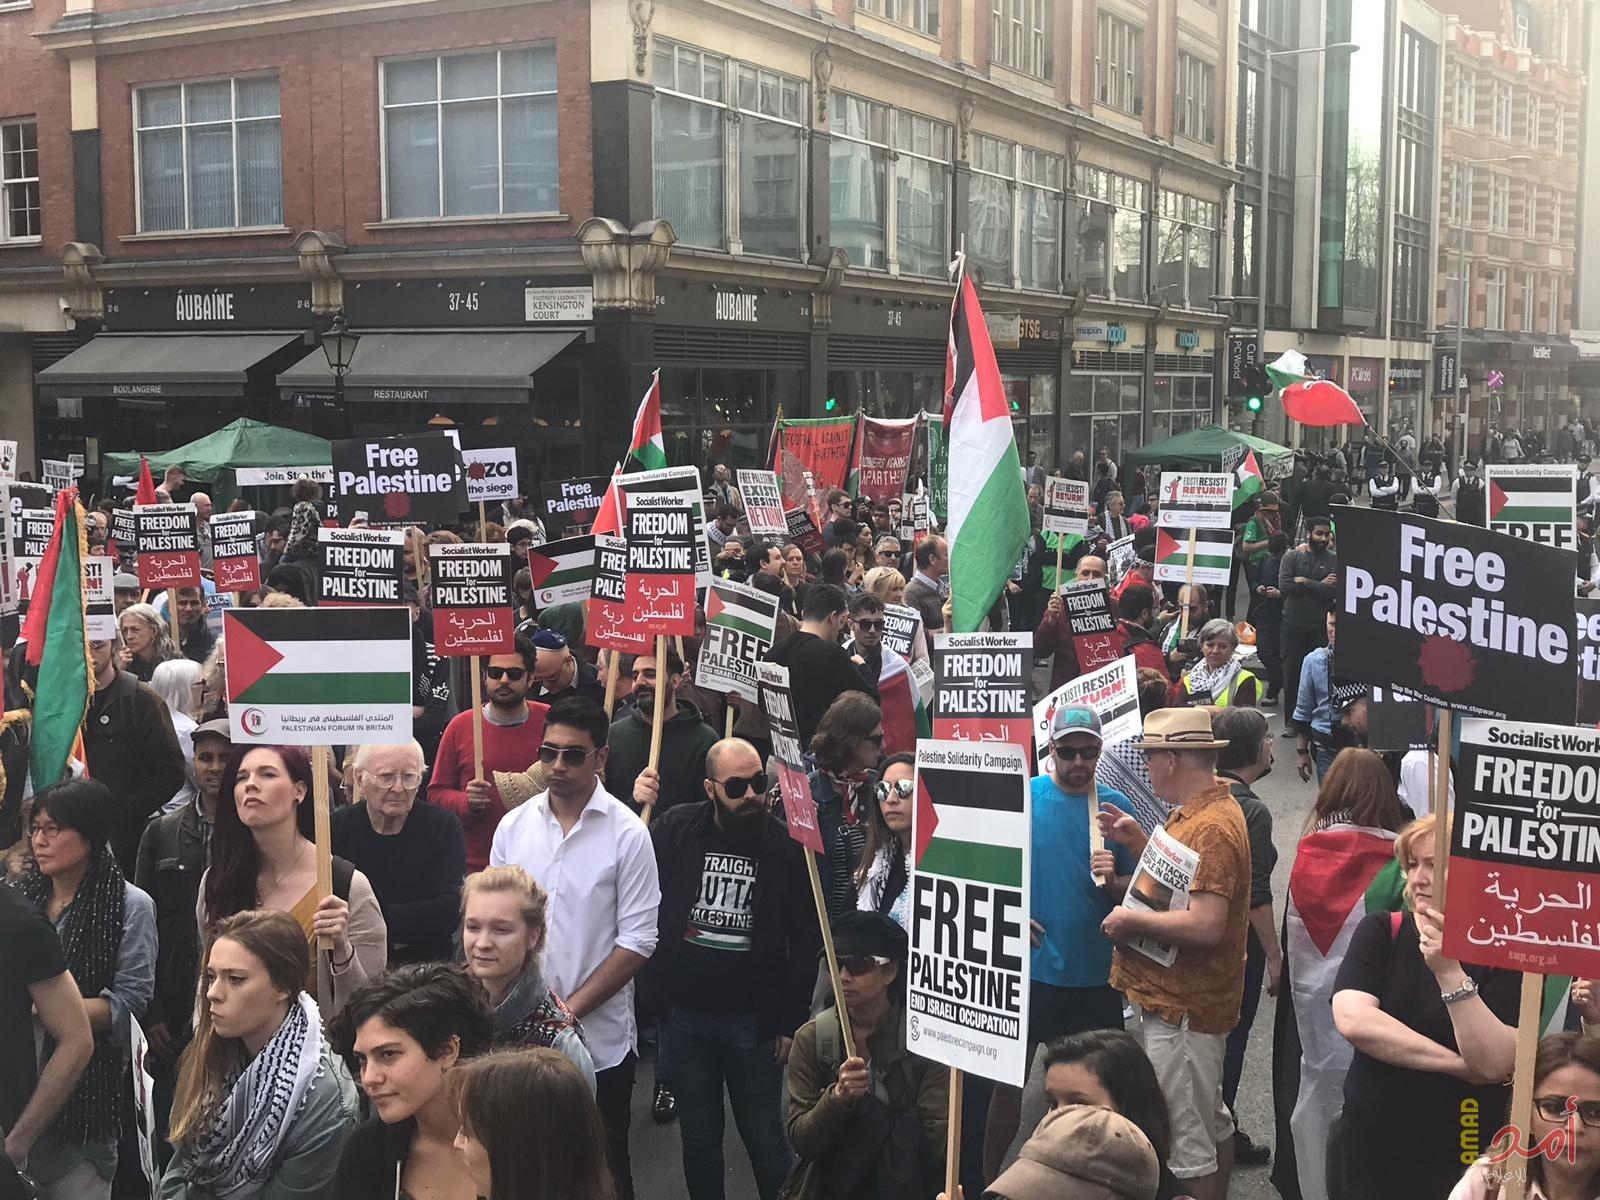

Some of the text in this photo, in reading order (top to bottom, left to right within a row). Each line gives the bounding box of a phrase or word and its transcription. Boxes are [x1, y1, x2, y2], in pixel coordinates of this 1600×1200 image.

[449, 292, 479, 312] 37-45
[533, 301, 584, 310] KENSINGTON
[716, 292, 758, 322] AUBAINE
[532, 310, 560, 320] COURT
[1076, 326, 1102, 335] maplin
[113, 386, 162, 394] BOULANGERIE
[374, 390, 428, 400] RESTAURANT
[786, 430, 848, 446] FOOTBALL AGAINST
[366, 444, 418, 468] Free
[264, 472, 284, 481] Join
[286, 471, 308, 480] St
[338, 469, 452, 496] Palestine
[740, 473, 775, 485] FREE PALESTINE
[1183, 476, 1227, 486] EXIST! RESIST!
[486, 483, 513, 494] siege
[561, 482, 592, 497] Free
[742, 485, 778, 498] EXIST!
[1056, 492, 1084, 502] RETURN!
[1183, 486, 1226, 495] RETURN!
[546, 494, 603, 514] Palestin
[745, 498, 780, 507] RESIST!
[140, 516, 190, 530] FREEDOM
[632, 513, 688, 534] FREEDOM
[748, 507, 785, 527] RETURN!
[214, 522, 250, 538] FREEDOM
[140, 534, 194, 550] PALESTINE
[214, 541, 254, 557] PALESTINE
[654, 535, 663, 546] for
[150, 554, 186, 568] الحرية
[326, 546, 394, 568] FREEDOM
[630, 548, 692, 569] PALESTINE
[1400, 523, 1506, 593] Free
[146, 568, 193, 582] لفلسطين
[222, 560, 248, 573] الحرية
[354, 568, 366, 577] for
[438, 560, 502, 577] FREEDOM
[220, 572, 253, 587] لفلسطين
[322, 576, 398, 599] PALESTINE
[466, 578, 476, 586] for
[436, 586, 508, 604] PALESTINE
[638, 579, 679, 600] الحرية
[1067, 592, 1105, 611] FREEDOM
[449, 612, 496, 629] الحرية
[632, 601, 684, 622] لفلسطين
[1345, 565, 1568, 665] Palestine
[1071, 614, 1114, 633] PALESTINE
[444, 629, 504, 647] لفلسطين
[1083, 636, 1111, 652] الحرية
[943, 653, 1022, 677] FREEDOM
[1085, 649, 1119, 666] لفلسطين
[975, 677, 988, 688] for
[1060, 665, 1125, 706] EXIST! RESIST!
[939, 690, 1026, 713] PALESTINE
[1072, 678, 1126, 707] TURN!
[1391, 682, 1404, 693] Stop
[1404, 686, 1413, 696] the
[1414, 688, 1423, 699] War
[1423, 694, 1448, 707] Coalition
[1451, 702, 1507, 720] www.stopwar.org
[281, 715, 306, 723] بريطانيا
[919, 750, 1023, 771] Palestine Solidarity Campaign
[1474, 754, 1600, 804] FREEDO
[1536, 800, 1561, 820] for
[1155, 866, 1163, 877] IN
[1163, 873, 1185, 892] GAZA
[1157, 858, 1190, 885] ATTACKS
[1484, 872, 1591, 914] الحرية
[691, 908, 753, 928] ALESTINE
[912, 874, 1022, 972] FREE
[1508, 951, 1558, 966] swp.org.uk
[911, 951, 1020, 1013] PALESTINE
[911, 994, 1018, 1038] END ISRAELI OCCUPATION
[923, 1027, 997, 1060] www.palestinecampaign.org
